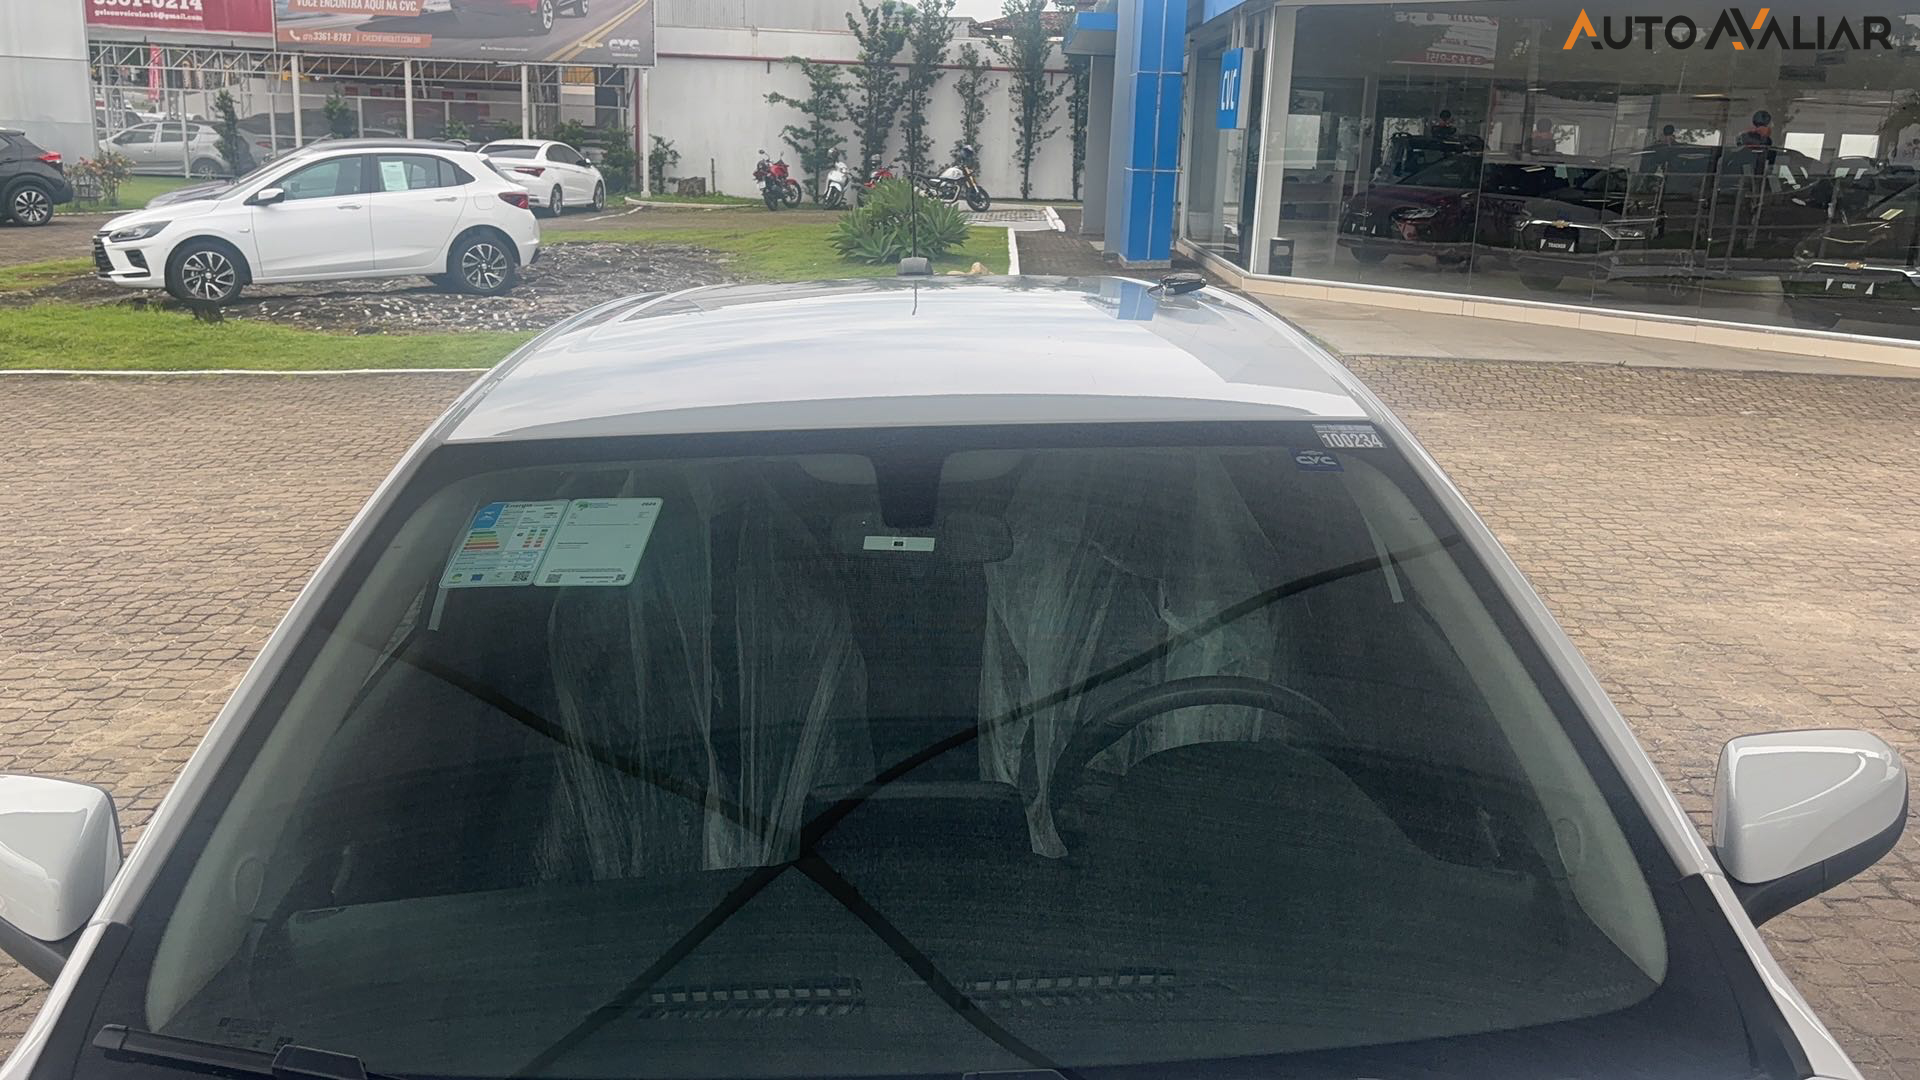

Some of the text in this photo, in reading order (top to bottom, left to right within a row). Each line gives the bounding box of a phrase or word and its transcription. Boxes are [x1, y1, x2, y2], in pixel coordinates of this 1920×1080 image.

[364, 0, 385, 11] AQUI
[386, 1, 398, 11] NA
[1321, 433, 1384, 448] 100234
